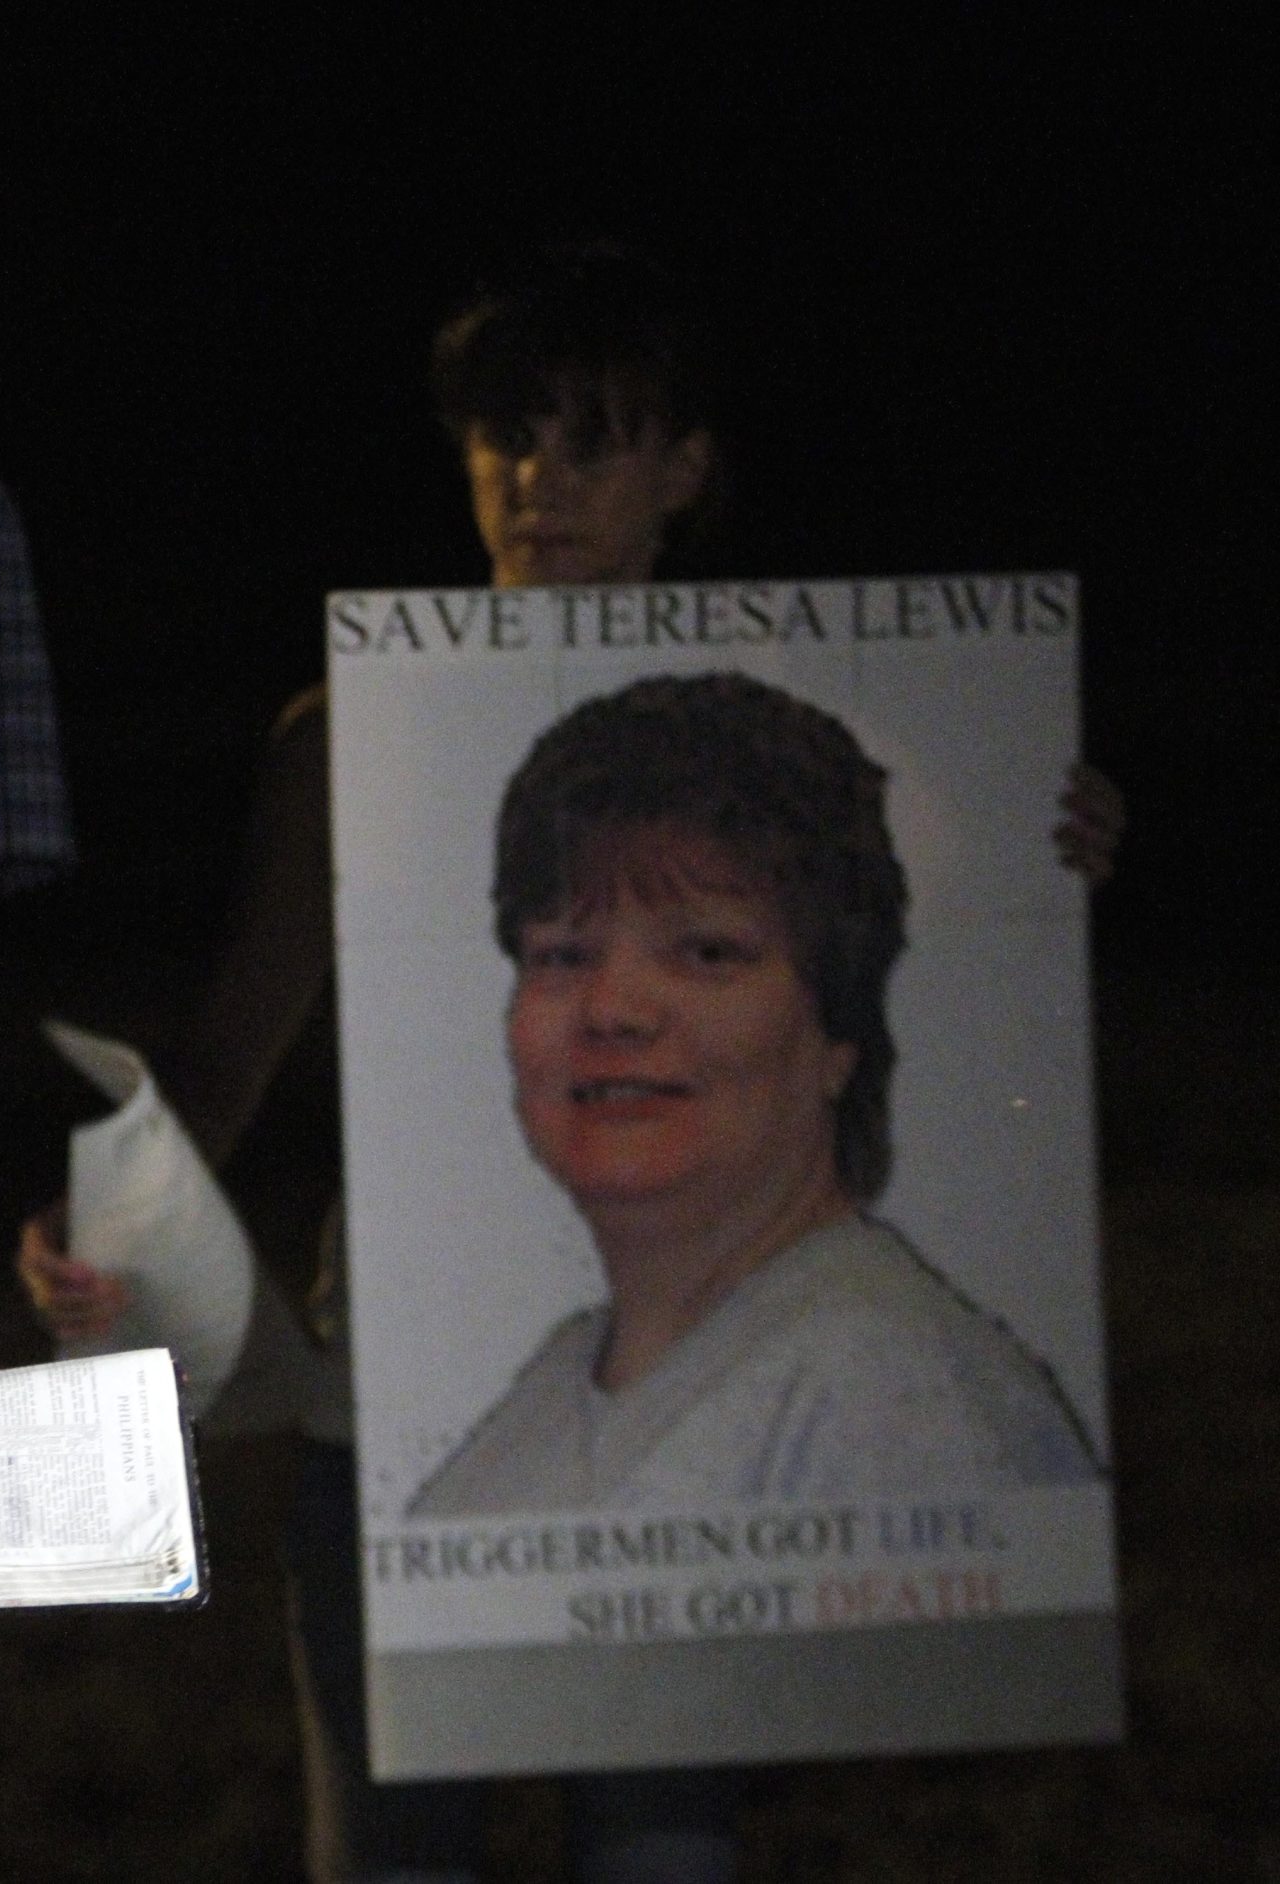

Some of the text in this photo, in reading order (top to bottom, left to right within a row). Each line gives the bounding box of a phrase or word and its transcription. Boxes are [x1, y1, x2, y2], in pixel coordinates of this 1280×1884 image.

[332, 576, 1069, 655] SAVE TERESA LEWIS
[115, 1394, 135, 1483] PHILIPPIANS
[137, 1389, 149, 1424] LETTER
[142, 1445, 153, 1468] PAUL
[366, 1516, 735, 1582] TRIGGERMEN
[744, 1508, 856, 1560] GOT
[567, 1567, 1003, 1641] SHE GOT DEATH
